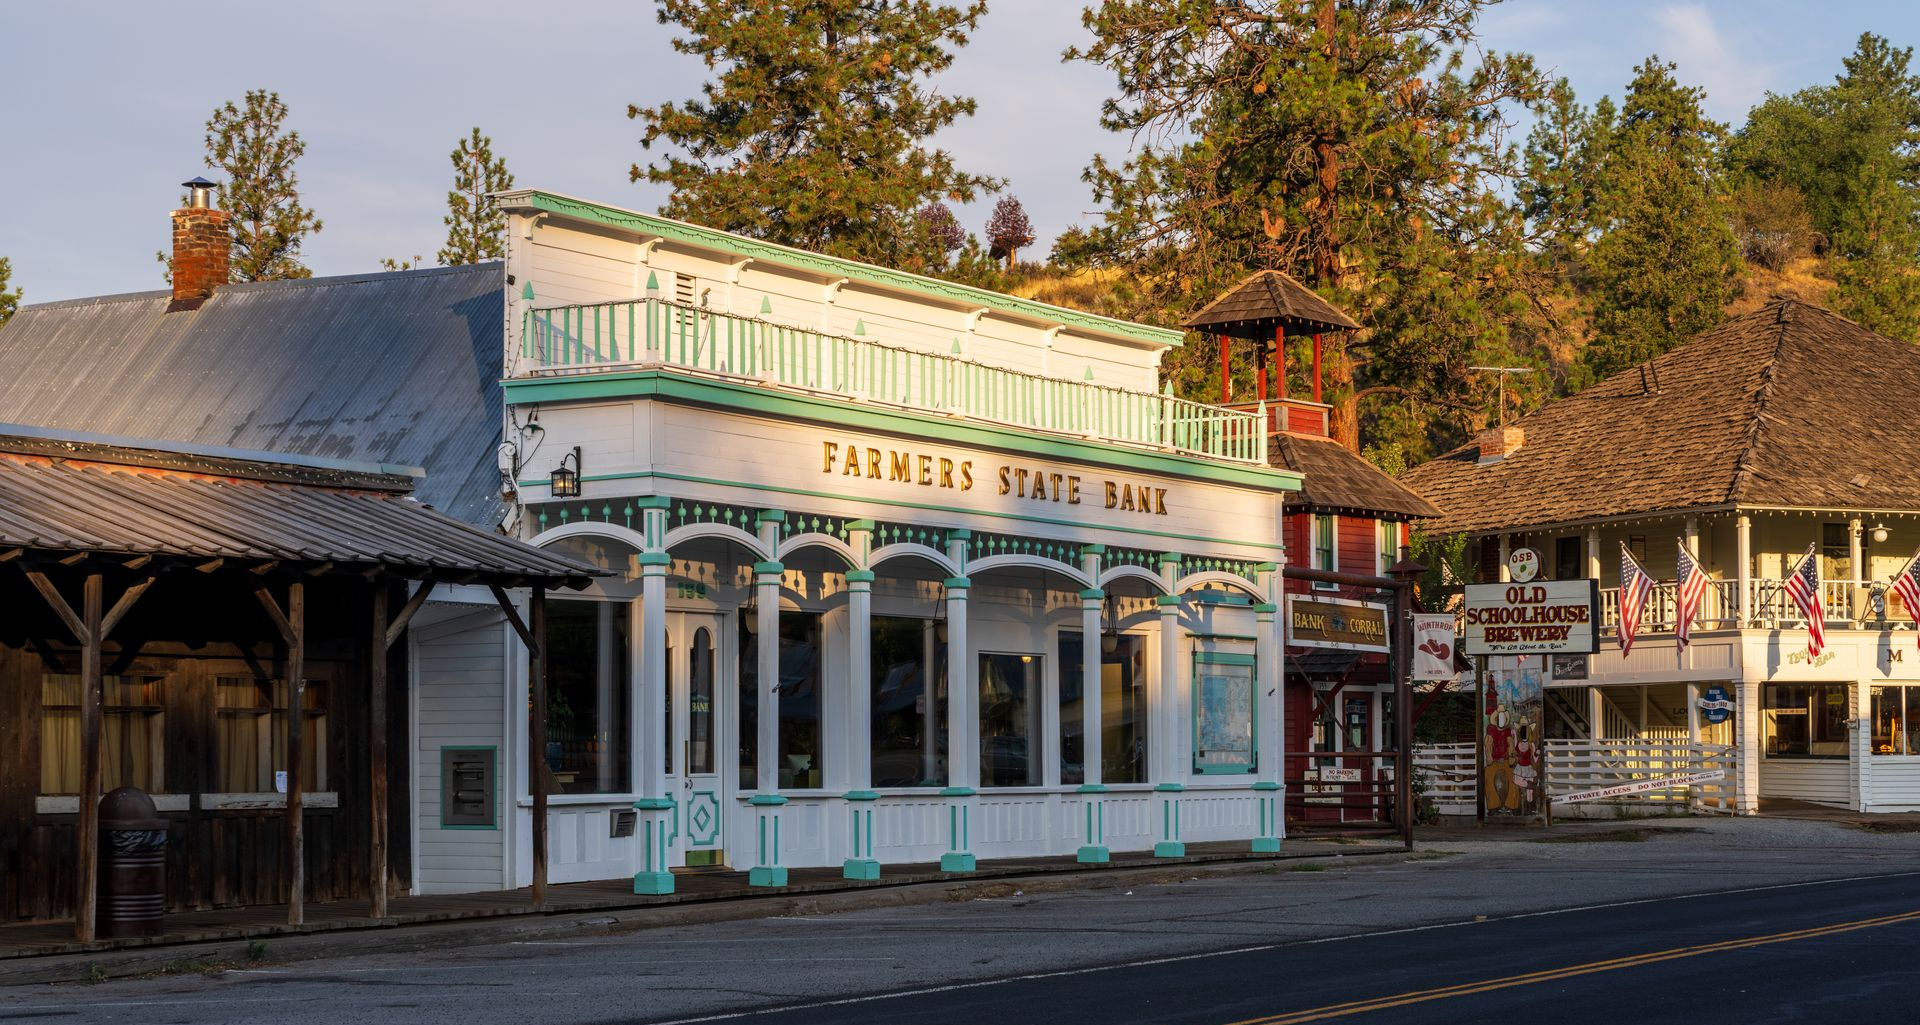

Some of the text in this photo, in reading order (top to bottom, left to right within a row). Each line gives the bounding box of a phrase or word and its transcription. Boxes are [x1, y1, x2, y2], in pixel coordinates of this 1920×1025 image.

[822, 440, 1169, 516] FARMERS STATE BANK
[1511, 552, 1534, 564] OSB
[1506, 586, 1547, 604] OLD
[1466, 605, 1590, 625] SCHOOLHOUSE
[1293, 612, 1384, 641] BANK CORRAL
[1416, 620, 1453, 632] WINTHROP
[1484, 625, 1573, 643] BREWERY
[1519, 642, 1537, 651] About
[1886, 649, 1904, 663] M
[690, 702, 710, 712] BANK
[1702, 701, 1717, 709] CARLOS
[1568, 791, 1601, 802] PRIVATE
[1602, 785, 1632, 796] ACCESS
[1637, 783, 1650, 791] DO
[1650, 780, 1667, 789] NOT
[1668, 776, 1695, 786] BLOCK
